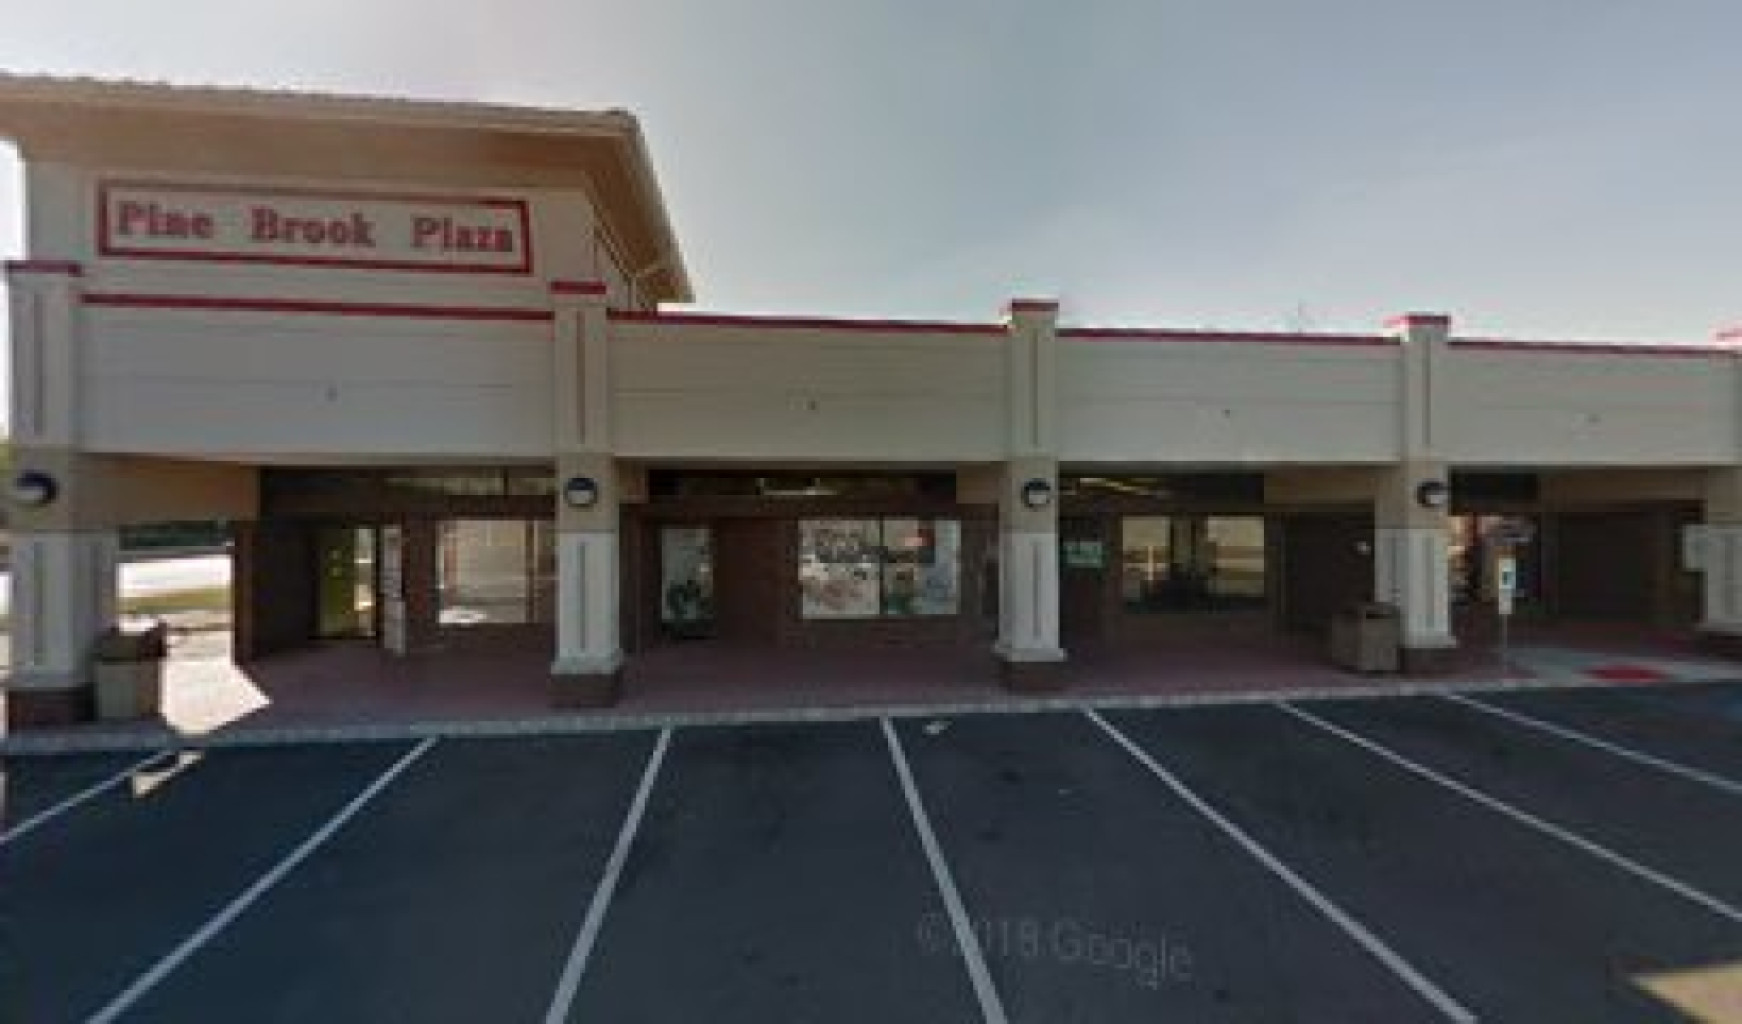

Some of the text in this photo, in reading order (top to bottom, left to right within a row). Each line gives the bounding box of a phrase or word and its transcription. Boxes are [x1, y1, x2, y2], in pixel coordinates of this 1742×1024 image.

[116, 200, 514, 253] Pine Brook Plaza
